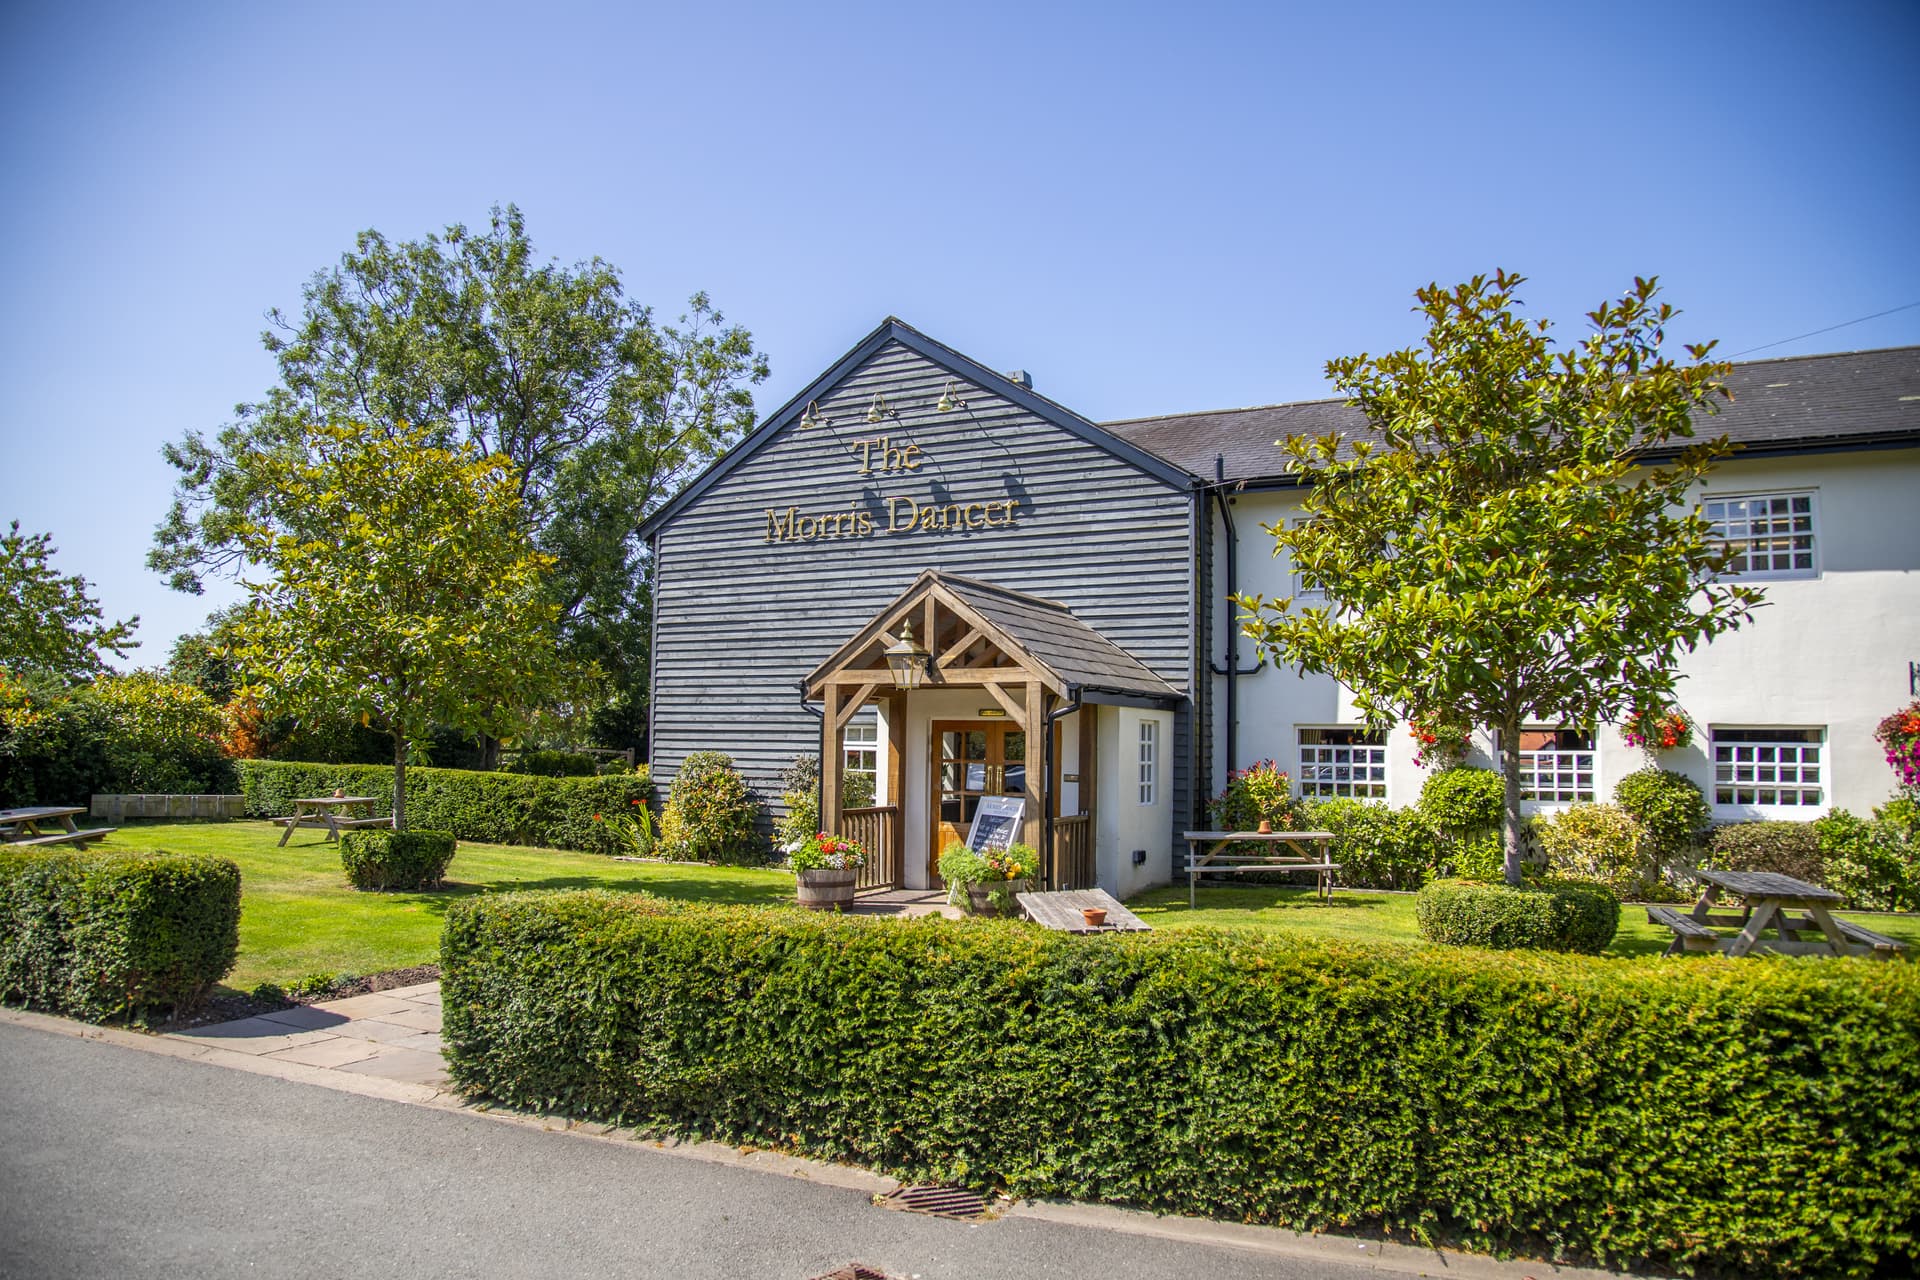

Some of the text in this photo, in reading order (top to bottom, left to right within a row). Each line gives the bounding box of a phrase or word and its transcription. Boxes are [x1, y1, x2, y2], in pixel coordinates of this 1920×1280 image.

[853, 436, 922, 474] The
[763, 496, 1020, 542] Morris Dancer
